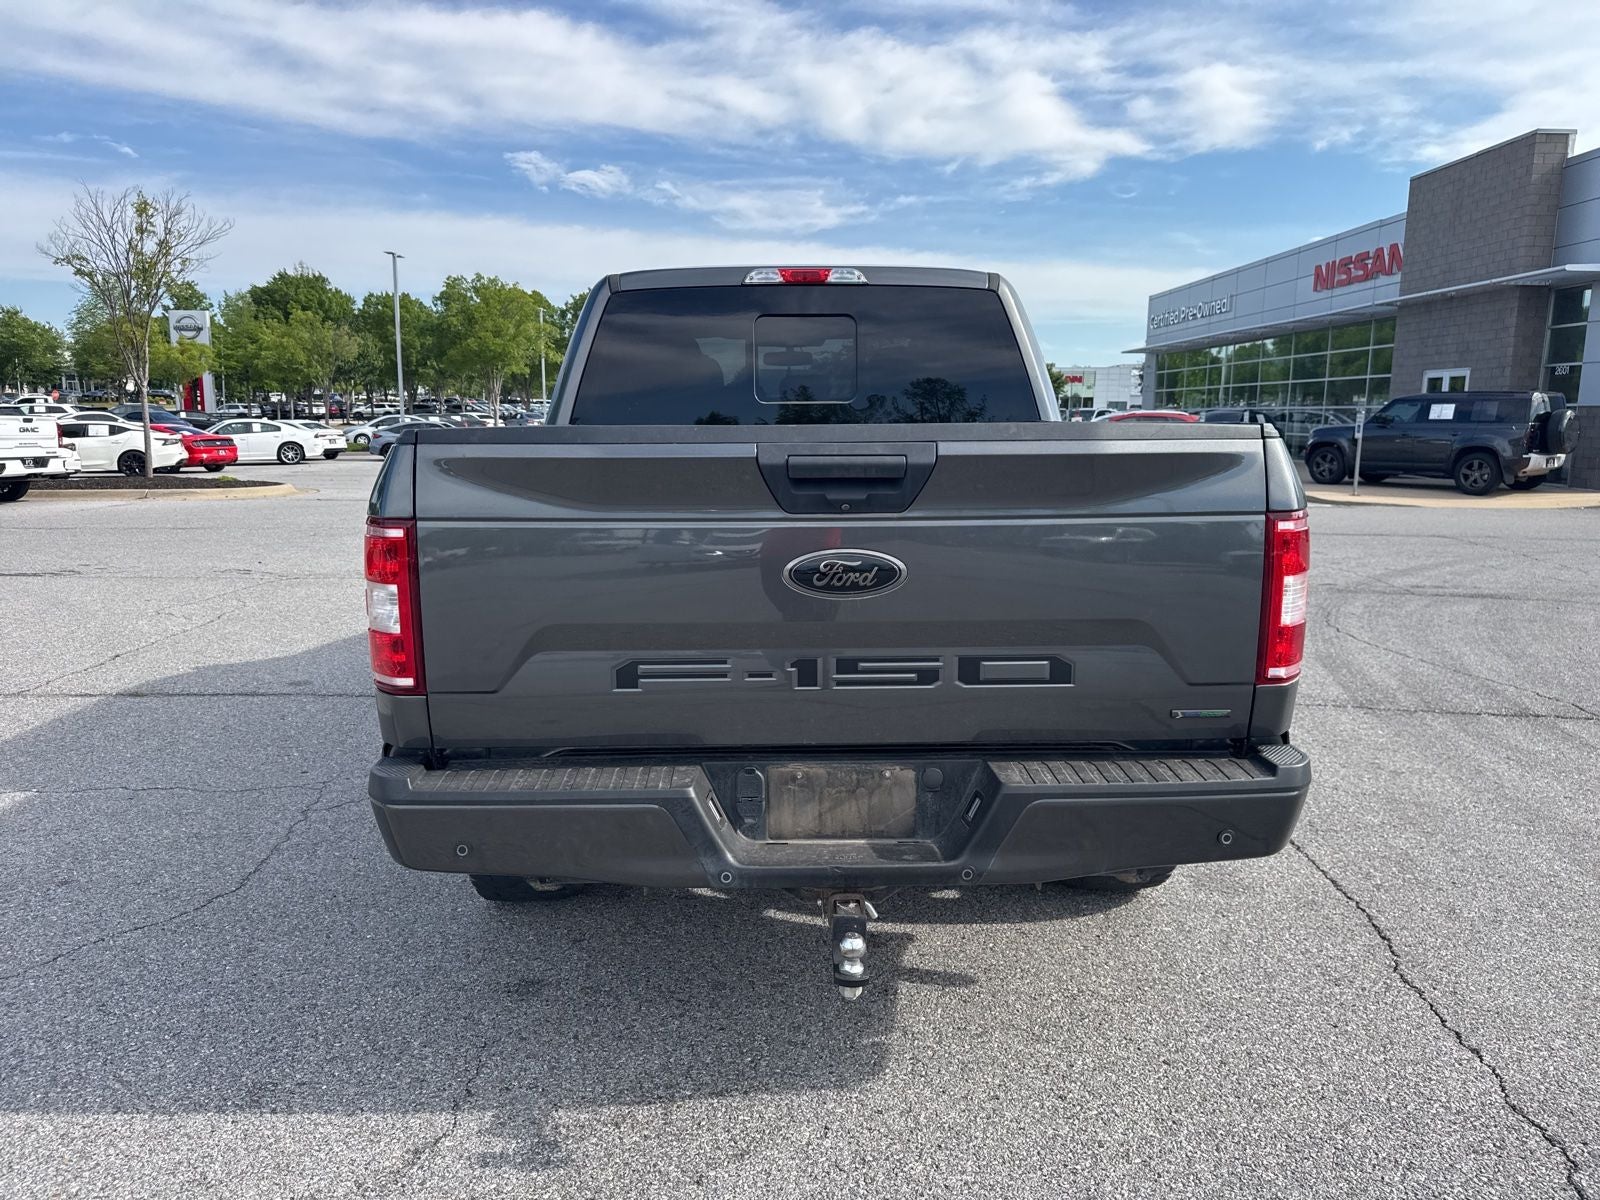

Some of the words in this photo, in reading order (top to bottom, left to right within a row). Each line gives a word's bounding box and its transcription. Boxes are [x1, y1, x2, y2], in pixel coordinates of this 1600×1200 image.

[1313, 243, 1403, 293] NISSAN
[1149, 309, 1179, 329] Certified
[1180, 294, 1231, 322] Pre-Owned
[812, 559, 879, 587] Ford
[612, 654, 1076, 692] F-150
